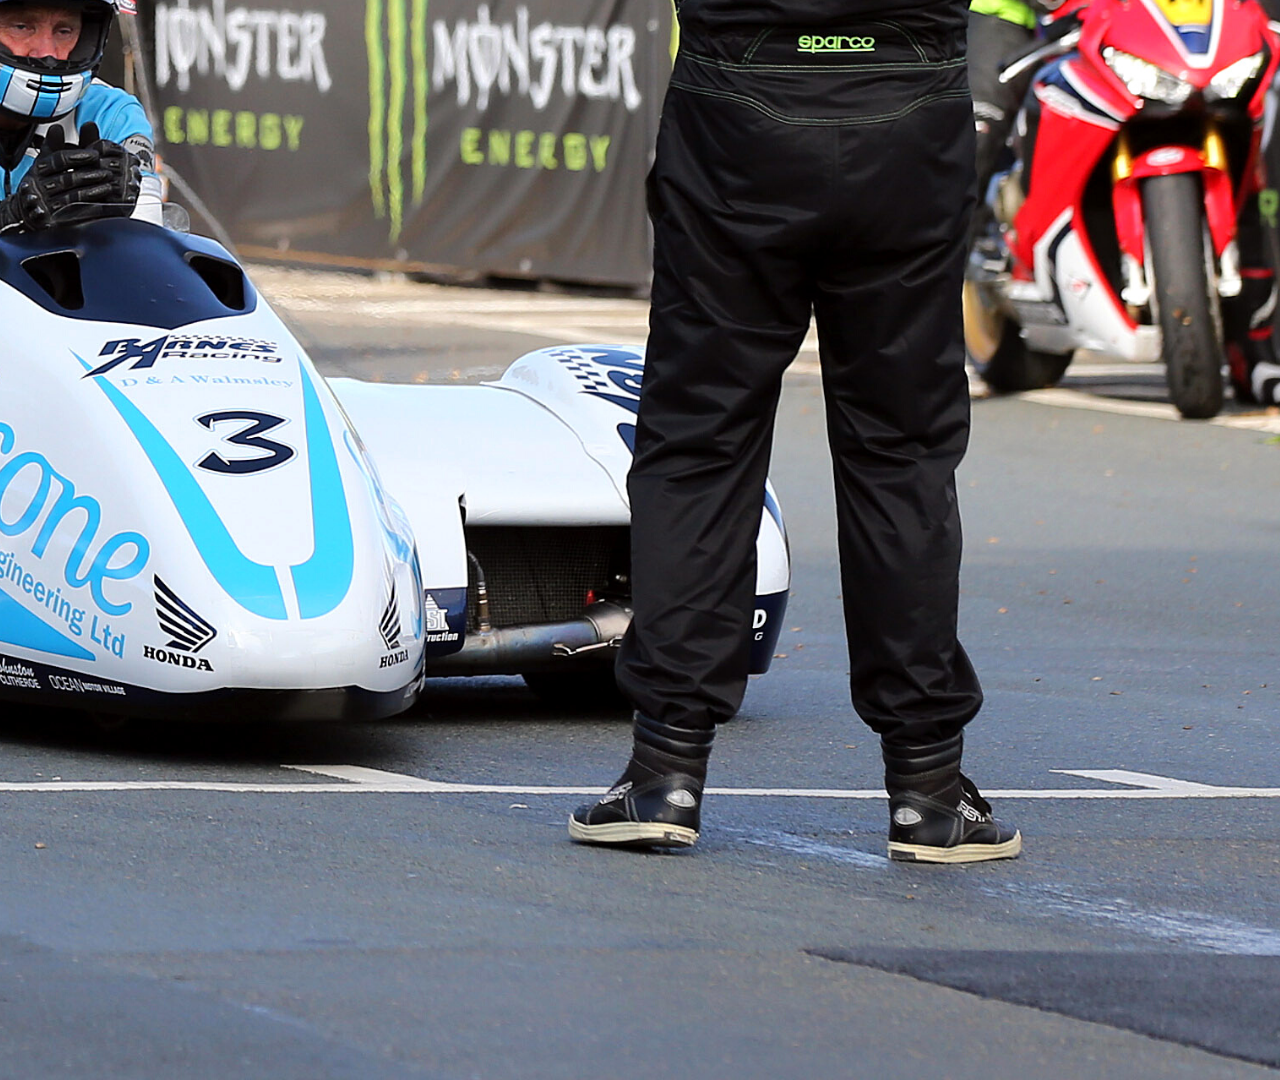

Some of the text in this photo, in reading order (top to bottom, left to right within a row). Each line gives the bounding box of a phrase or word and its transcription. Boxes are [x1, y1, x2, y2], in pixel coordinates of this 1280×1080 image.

[797, 33, 876, 53] sparco
[432, 4, 642, 111] MONSTER
[164, 107, 303, 150] ENERGY
[460, 127, 610, 172] ENERGY
[80, 334, 278, 379] BARNES
[161, 351, 283, 364] Racing
[121, 374, 293, 389] D & A Walmsley
[196, 411, 295, 474] 3
[90, 614, 126, 659] Ltd
[427, 631, 458, 642] ruction
[143, 645, 214, 672] HONDA
[379, 650, 410, 669] HONDA
[48, 674, 85, 693] OCEAN
